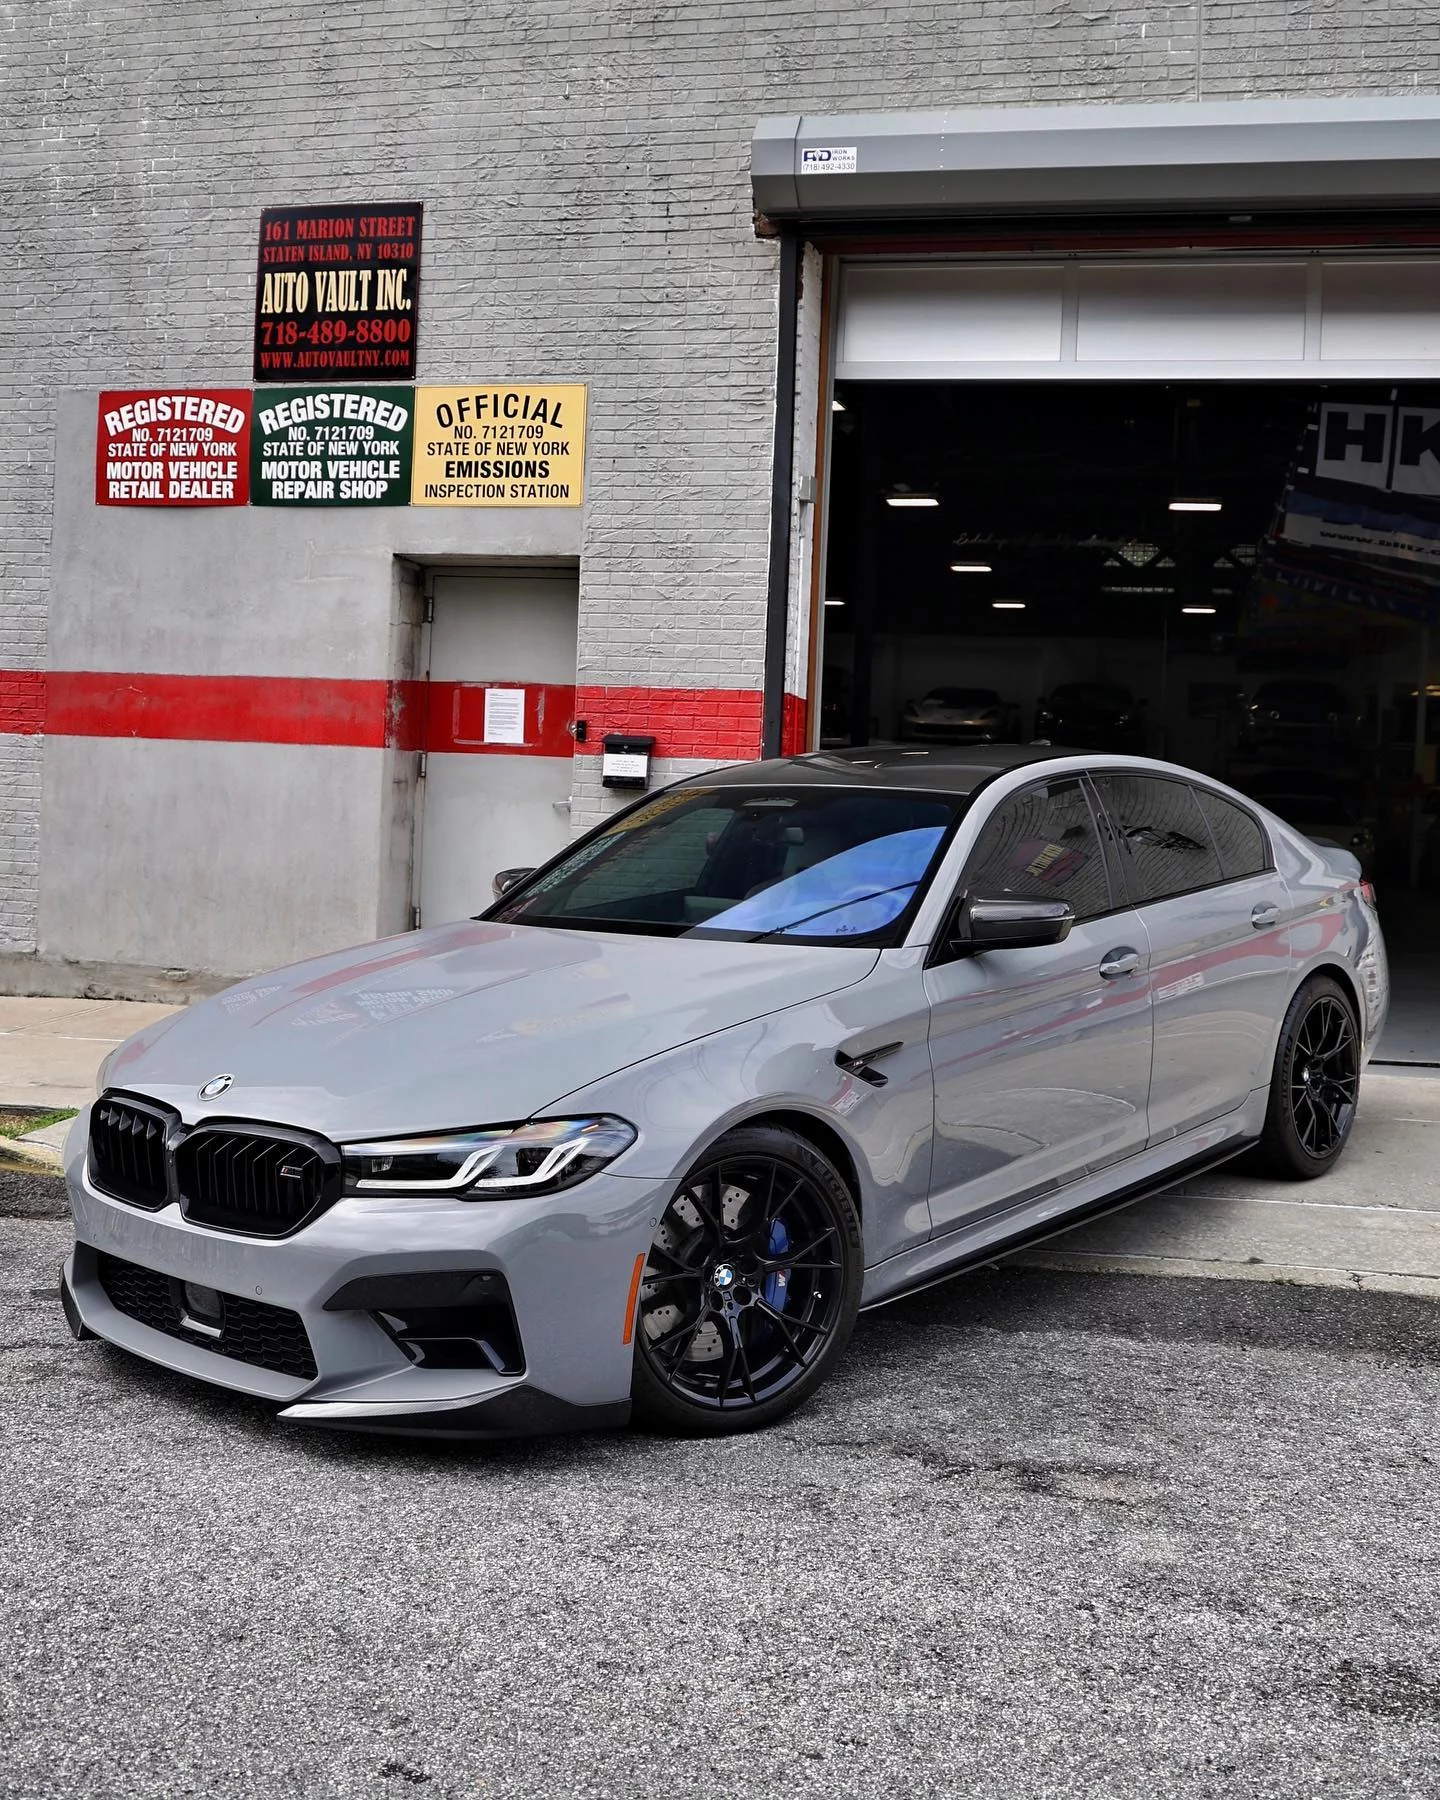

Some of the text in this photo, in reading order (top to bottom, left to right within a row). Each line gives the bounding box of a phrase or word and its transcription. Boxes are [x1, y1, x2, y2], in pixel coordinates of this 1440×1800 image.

[803, 162, 855, 171] (718) 492-4330
[265, 216, 415, 241] 161 MARION STREET
[263, 243, 414, 263] STATEN ISLAND, NY 10310
[261, 268, 412, 314] AUTO VAULT INC.
[261, 319, 411, 345] 718-489-8800
[261, 349, 410, 369] WWW.AUTOVAULTNY.COM
[104, 396, 245, 437] REGISTERED
[258, 393, 408, 436] REGISTERED
[436, 393, 565, 429] OFFICIAL
[132, 427, 213, 442] NO. 7121709
[288, 426, 374, 441] NO. 7121709
[454, 425, 544, 439] NO. 7121709
[108, 442, 237, 457] STATE OF NEW YORK
[263, 440, 399, 457] STATE OF NEW YORK
[427, 441, 570, 456] STATE OF NEW YORK
[106, 461, 238, 480] MOTOR VEHICLE
[261, 460, 400, 480] MOTOR VEHICLE
[445, 460, 550, 478] EMISSIONS
[109, 481, 234, 499] RETAIL DEALER
[272, 480, 388, 499] REPAIR SHOP
[425, 484, 570, 498] INSPECTION STATION
